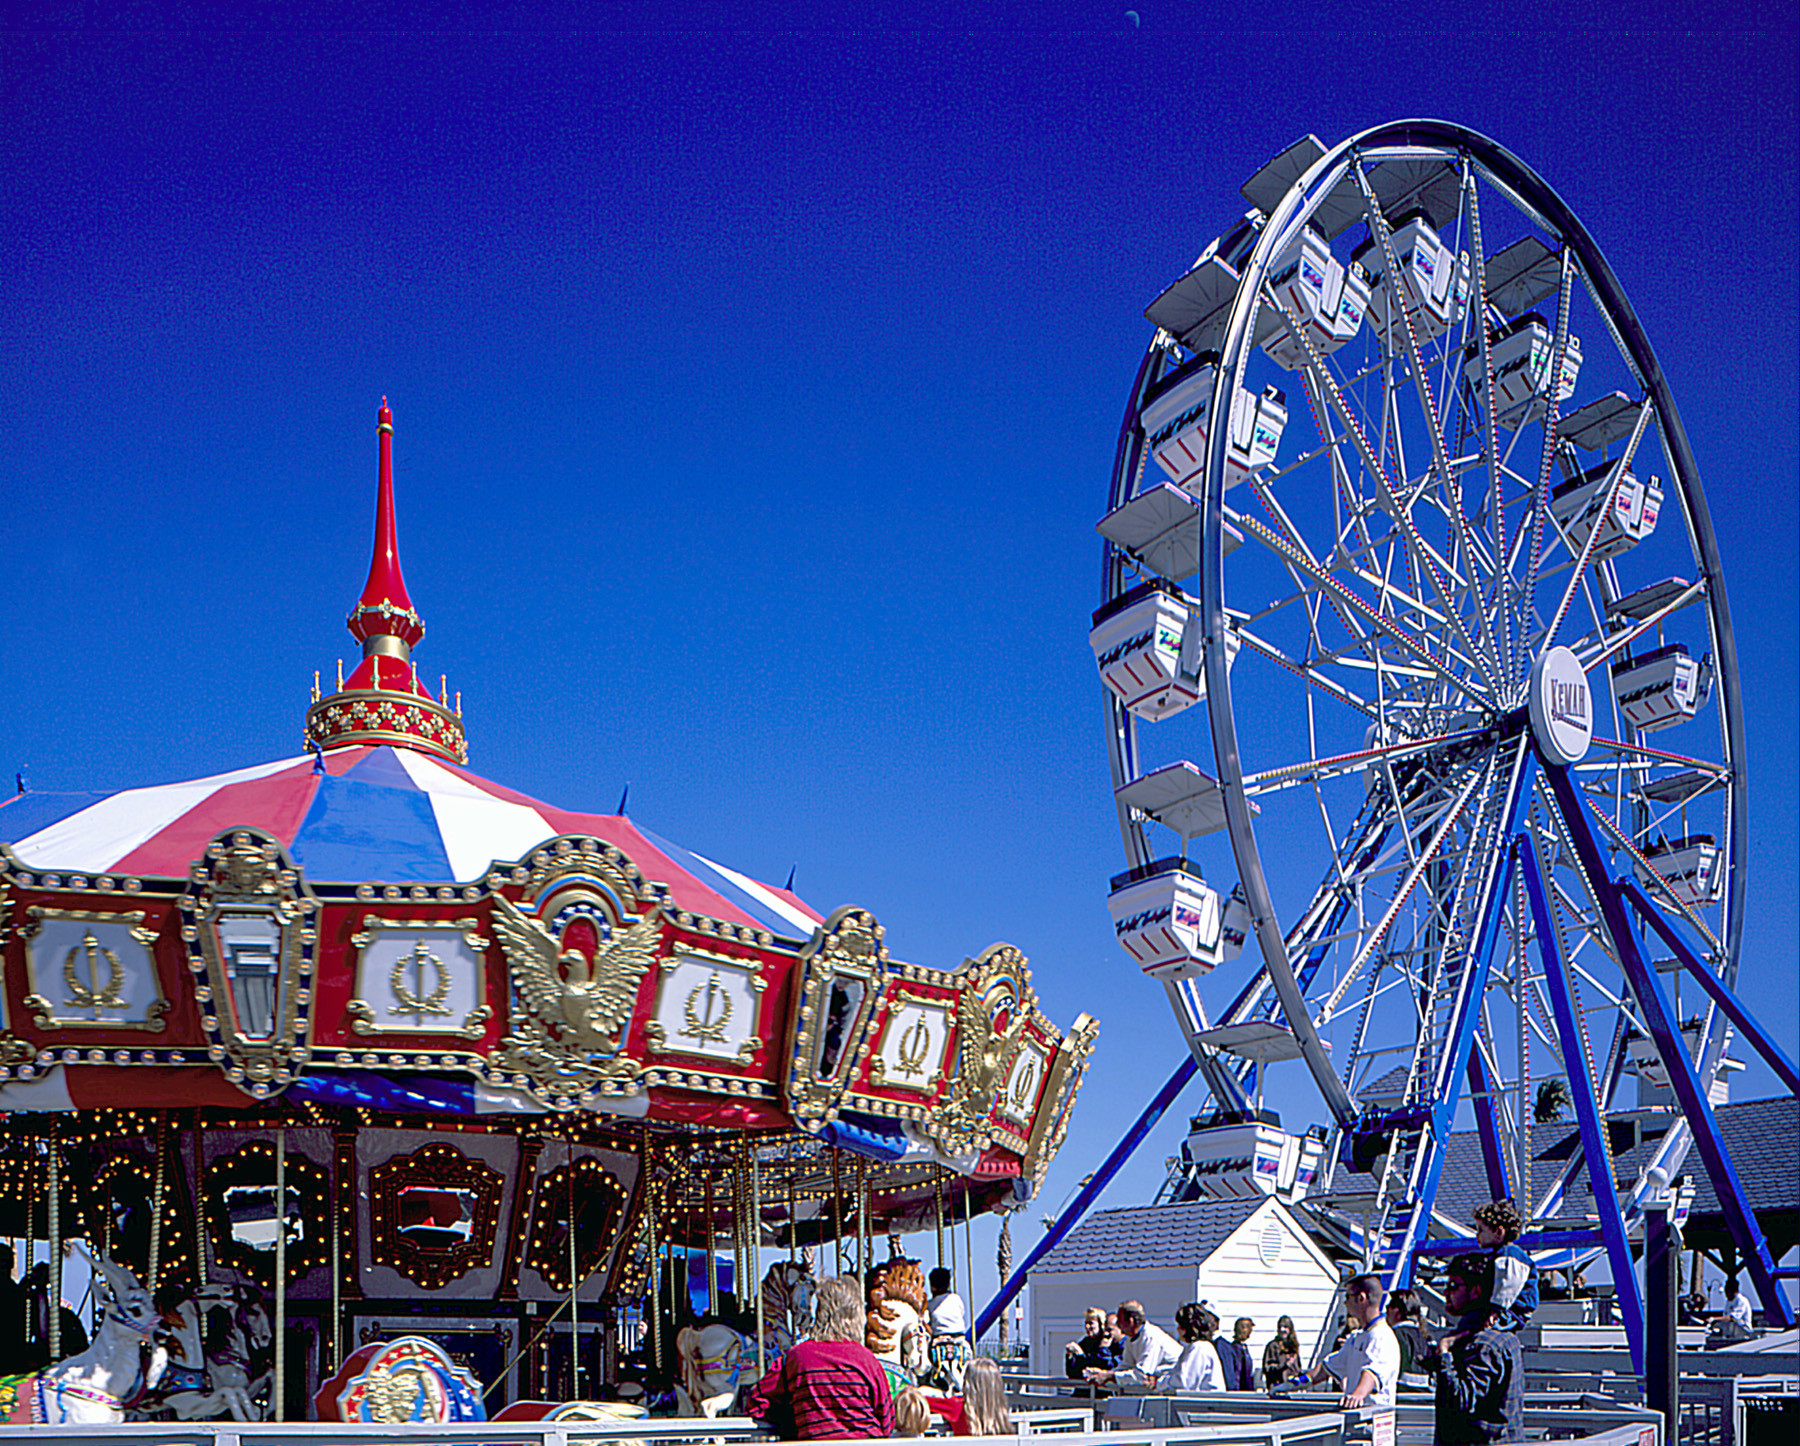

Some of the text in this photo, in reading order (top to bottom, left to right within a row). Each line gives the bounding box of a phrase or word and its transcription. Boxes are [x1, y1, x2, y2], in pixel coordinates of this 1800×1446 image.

[1568, 334, 1581, 350] 10
[1266, 384, 1278, 400] 7
[1551, 679, 1586, 718] KEMAH
